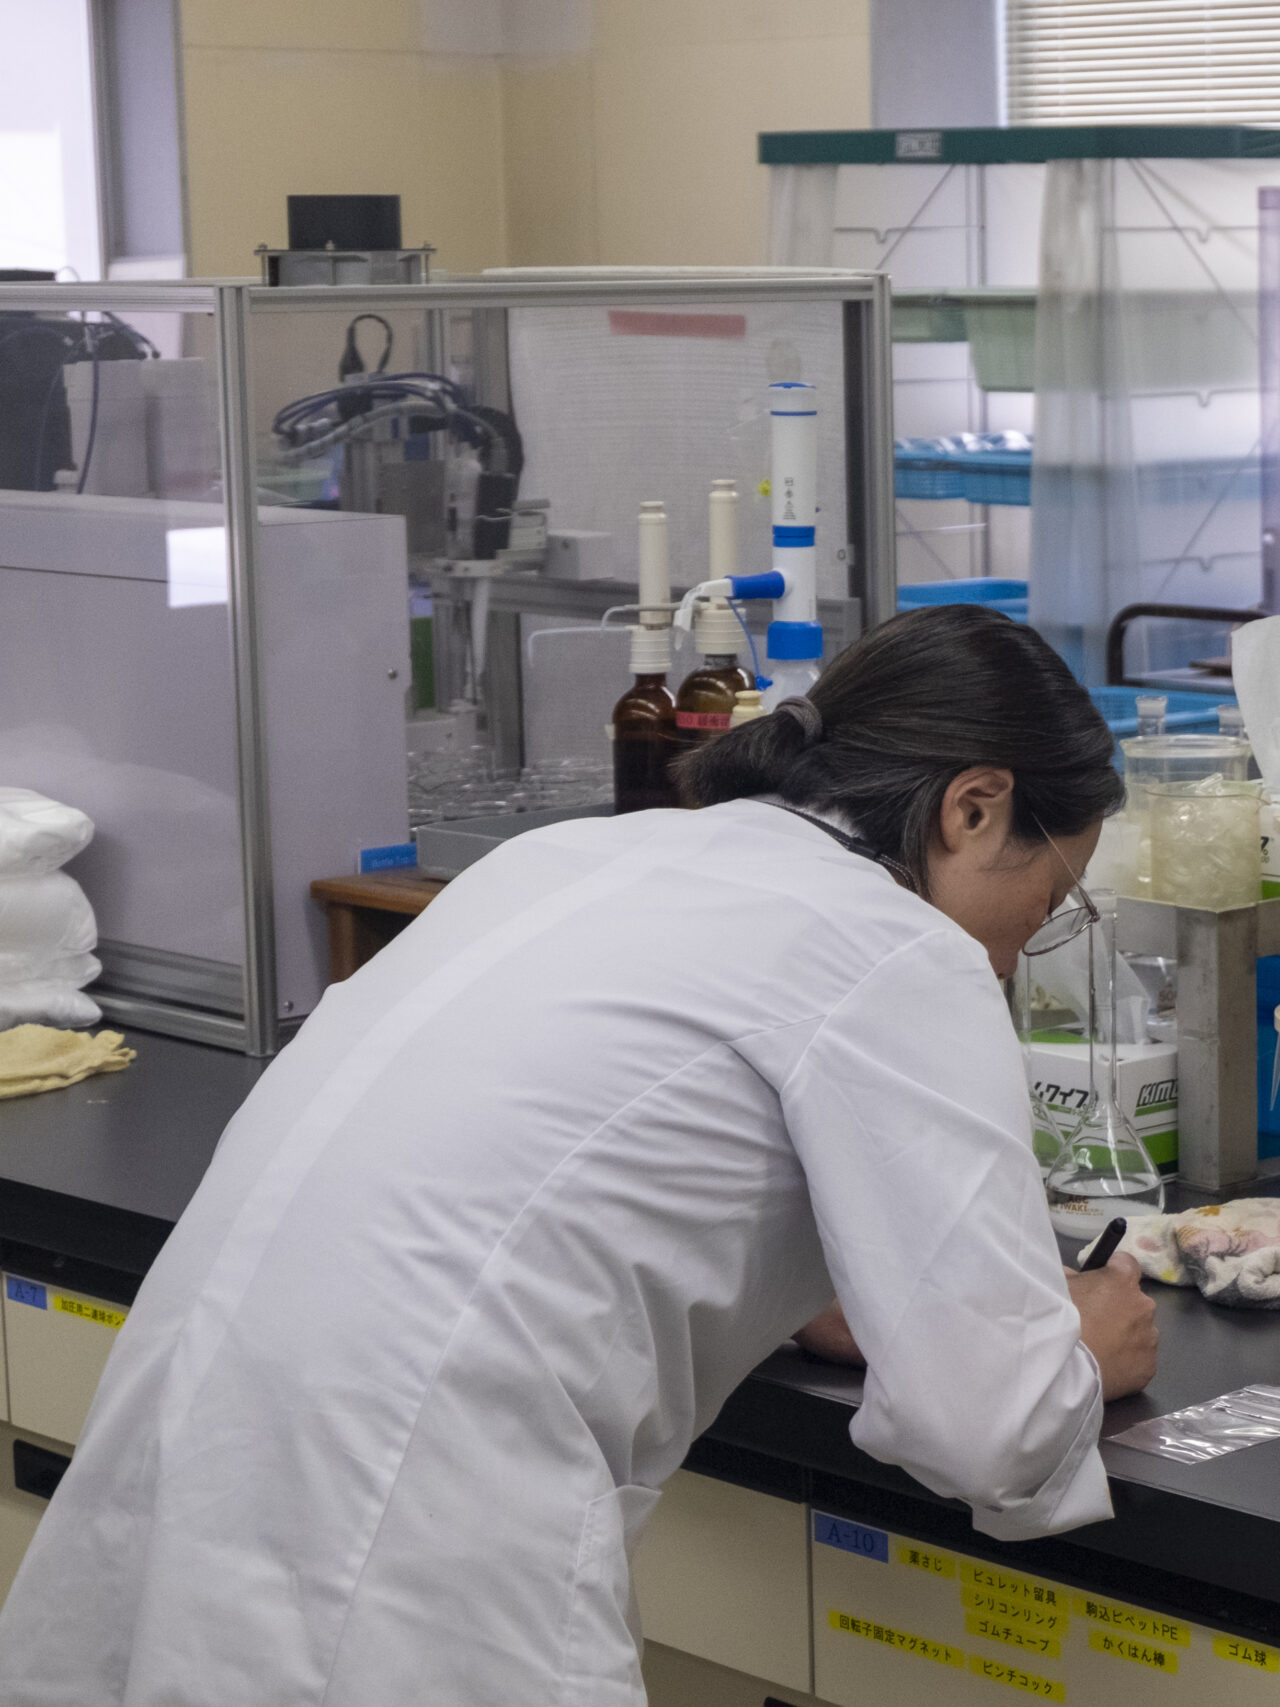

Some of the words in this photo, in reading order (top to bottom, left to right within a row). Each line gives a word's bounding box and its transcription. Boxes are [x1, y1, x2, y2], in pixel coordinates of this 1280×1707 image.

[15, 1283, 38, 1302] A-7
[827, 1522, 875, 1553] A-10
[909, 1550, 943, 1571] 薬さじ
[974, 1593, 1057, 1629] シリコンリング
[839, 1614, 952, 1662] 回転子固定マグネット
[979, 1620, 1049, 1651] ゴムチューブ
[1103, 1636, 1165, 1667] かくはん棒
[1228, 1643, 1267, 1666] ゴム球
